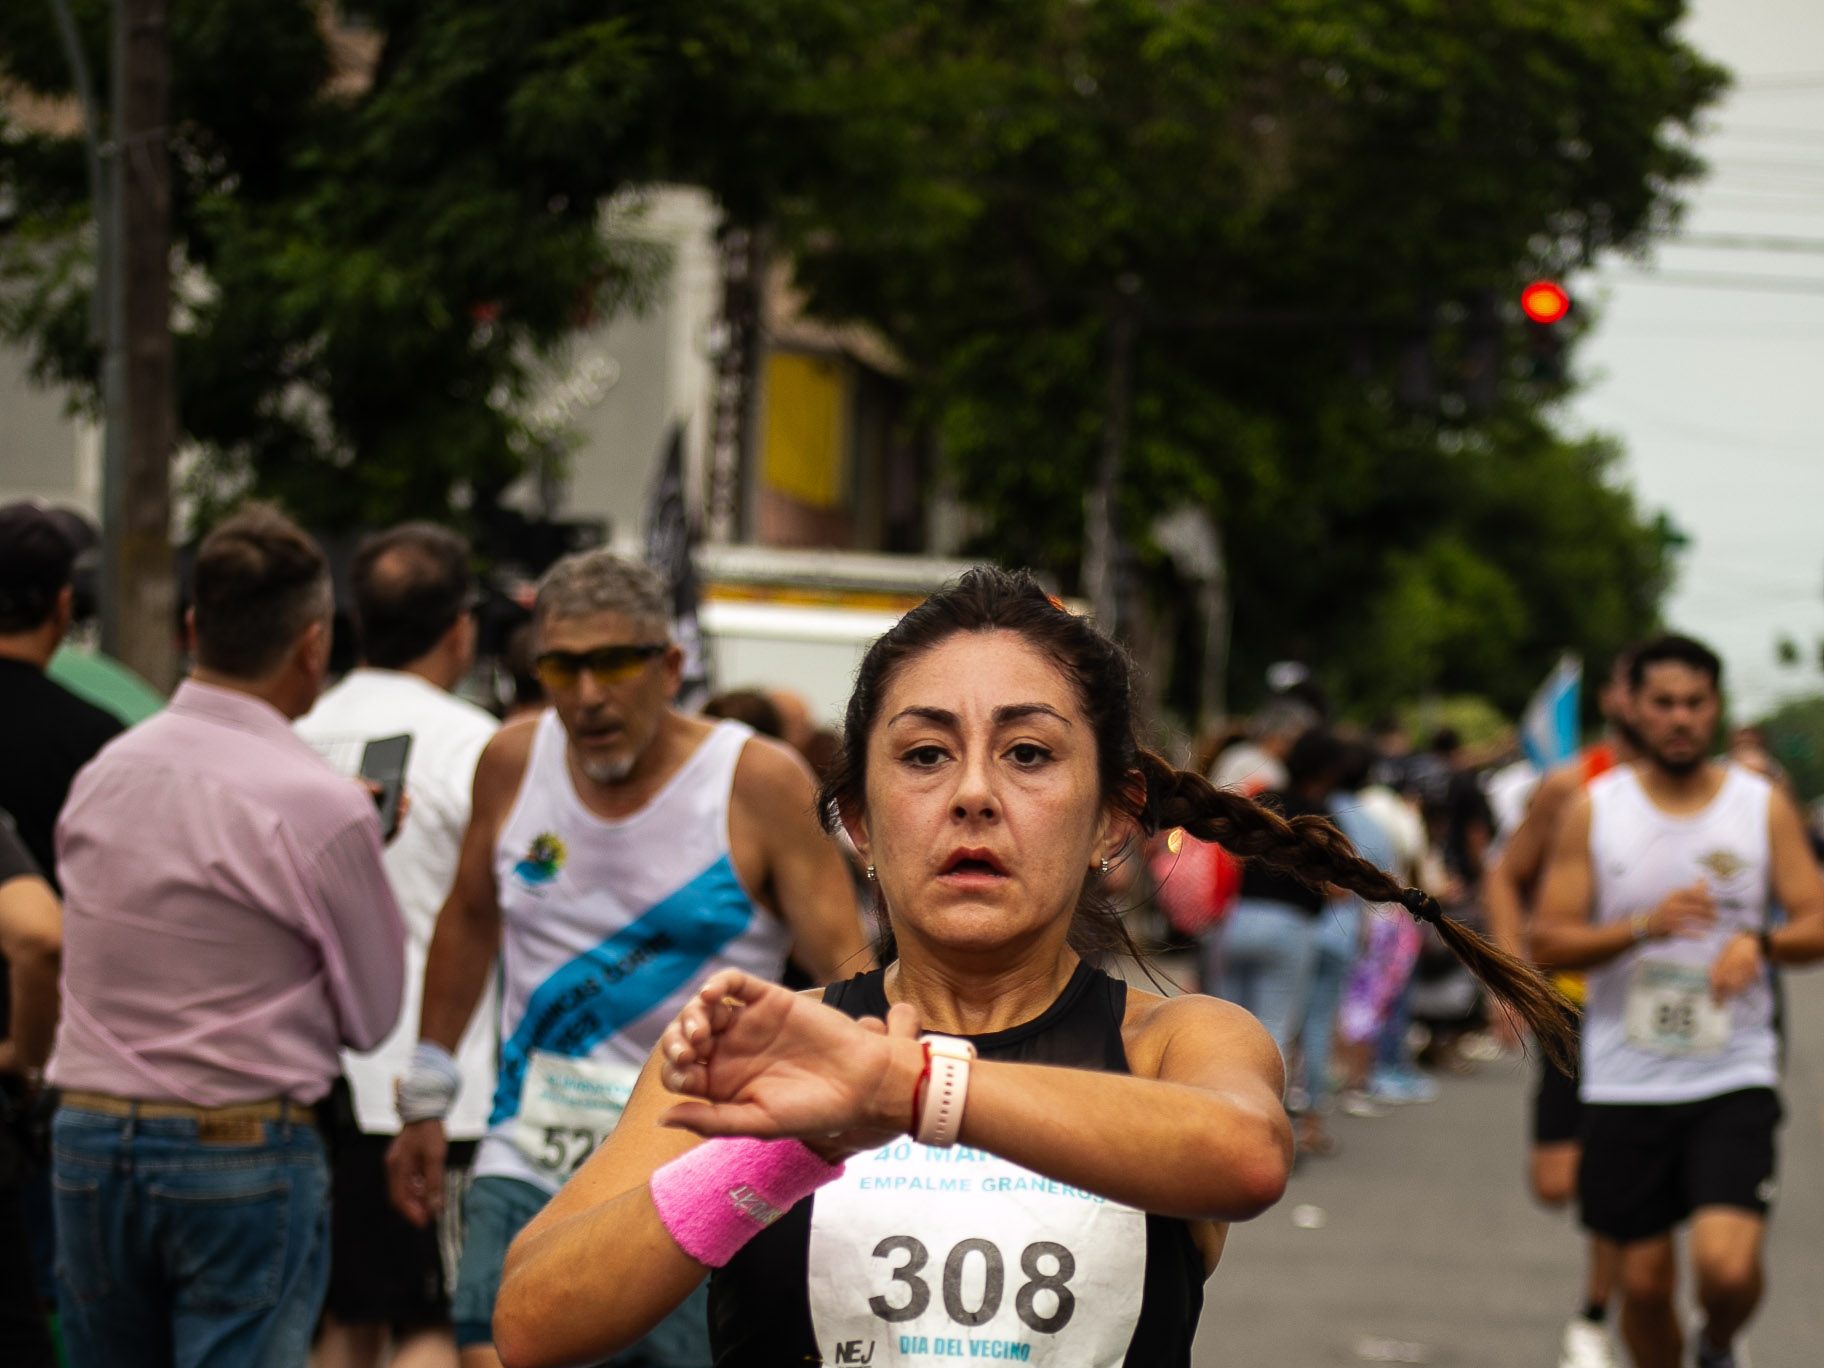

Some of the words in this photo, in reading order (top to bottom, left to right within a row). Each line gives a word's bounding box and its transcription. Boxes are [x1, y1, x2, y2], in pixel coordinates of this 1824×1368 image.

[538, 1125, 609, 1172] 52
[859, 1176, 972, 1192] EMPALME
[868, 1235, 1076, 1334] 308
[900, 1335, 928, 1354] DIA
[934, 1338, 963, 1357] DEL
[969, 1340, 1031, 1362] VECINO
